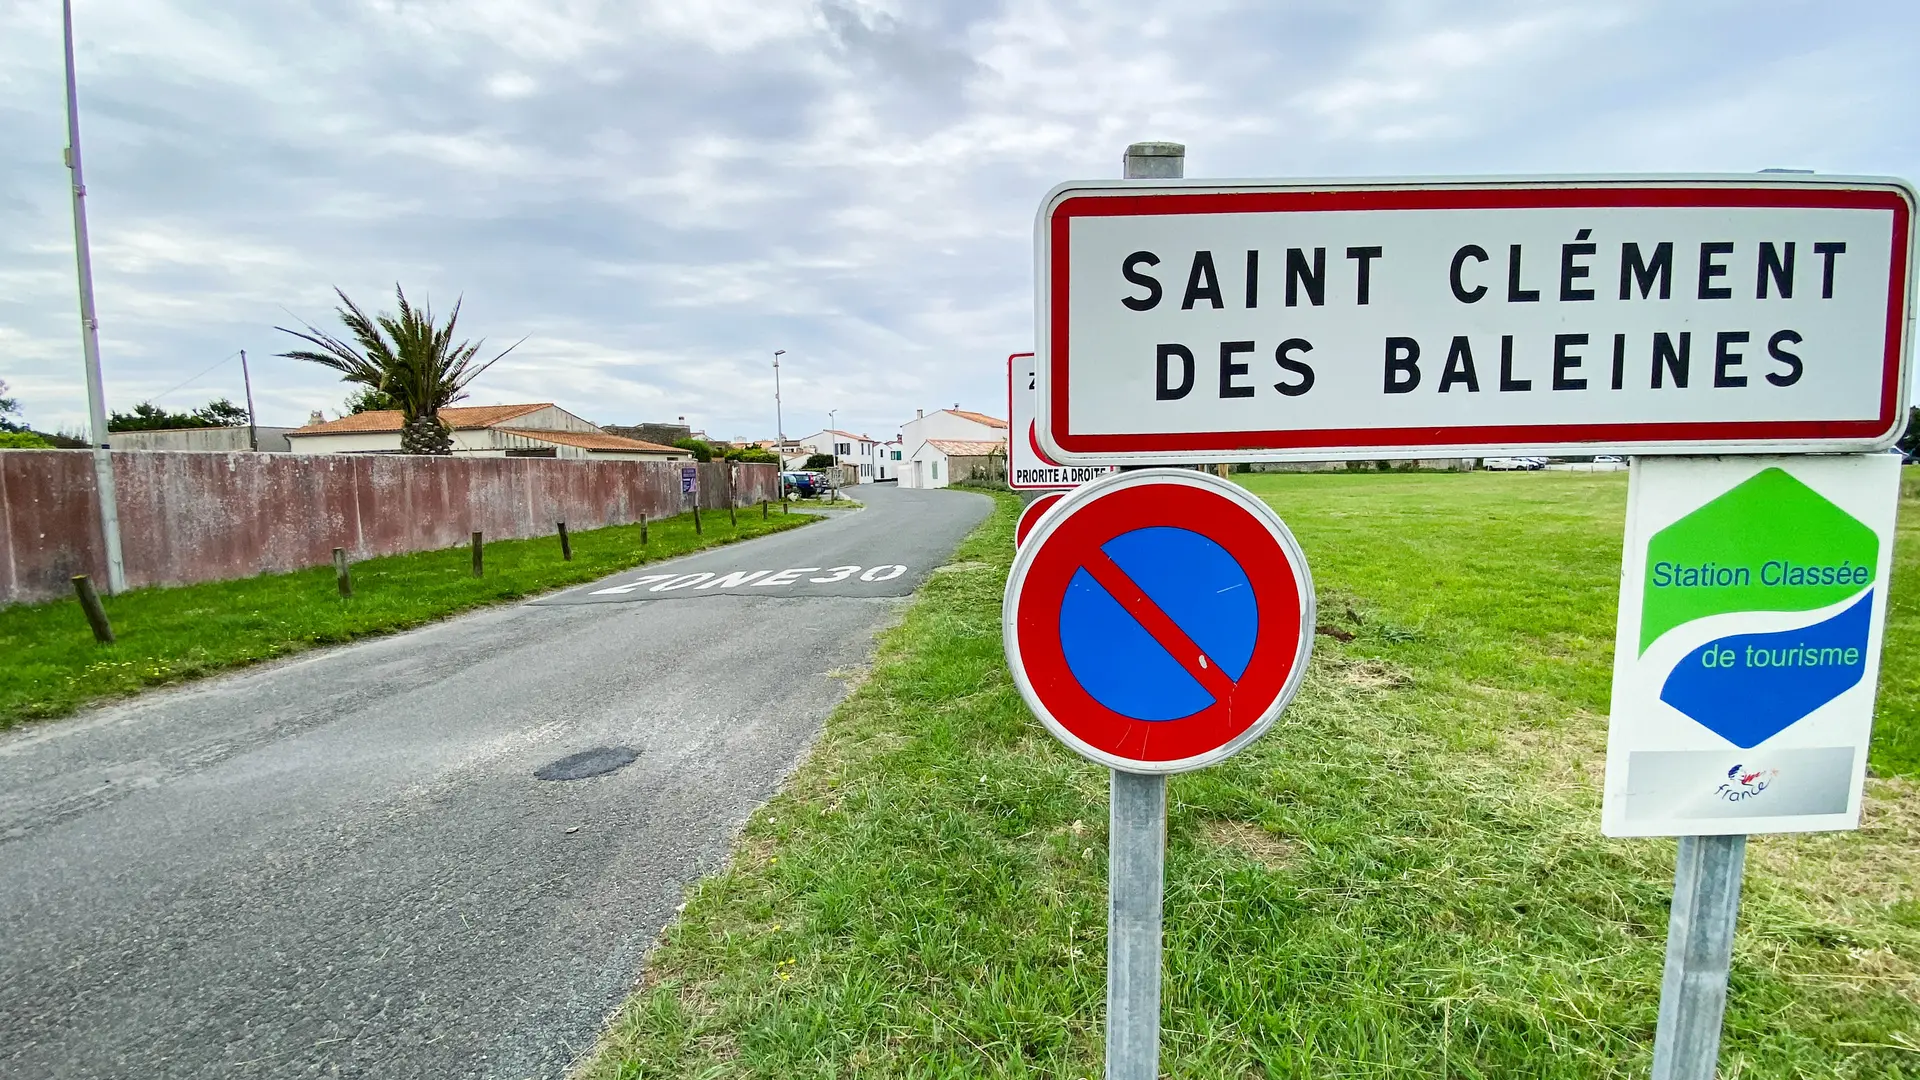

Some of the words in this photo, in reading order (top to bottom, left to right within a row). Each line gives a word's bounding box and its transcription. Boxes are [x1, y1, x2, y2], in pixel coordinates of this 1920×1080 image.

[1120, 245, 1383, 312] SAINT
[1449, 228, 1847, 304] CLÉMENT
[1156, 336, 1315, 401] DES
[1383, 329, 1804, 395] BALEINES
[1016, 468, 1060, 483] PRIORITE
[1061, 468, 1069, 482] A
[1652, 561, 1750, 587] Station
[1760, 560, 1869, 586] Classée
[1701, 644, 1736, 668] de
[1745, 642, 1860, 667] tourisme
